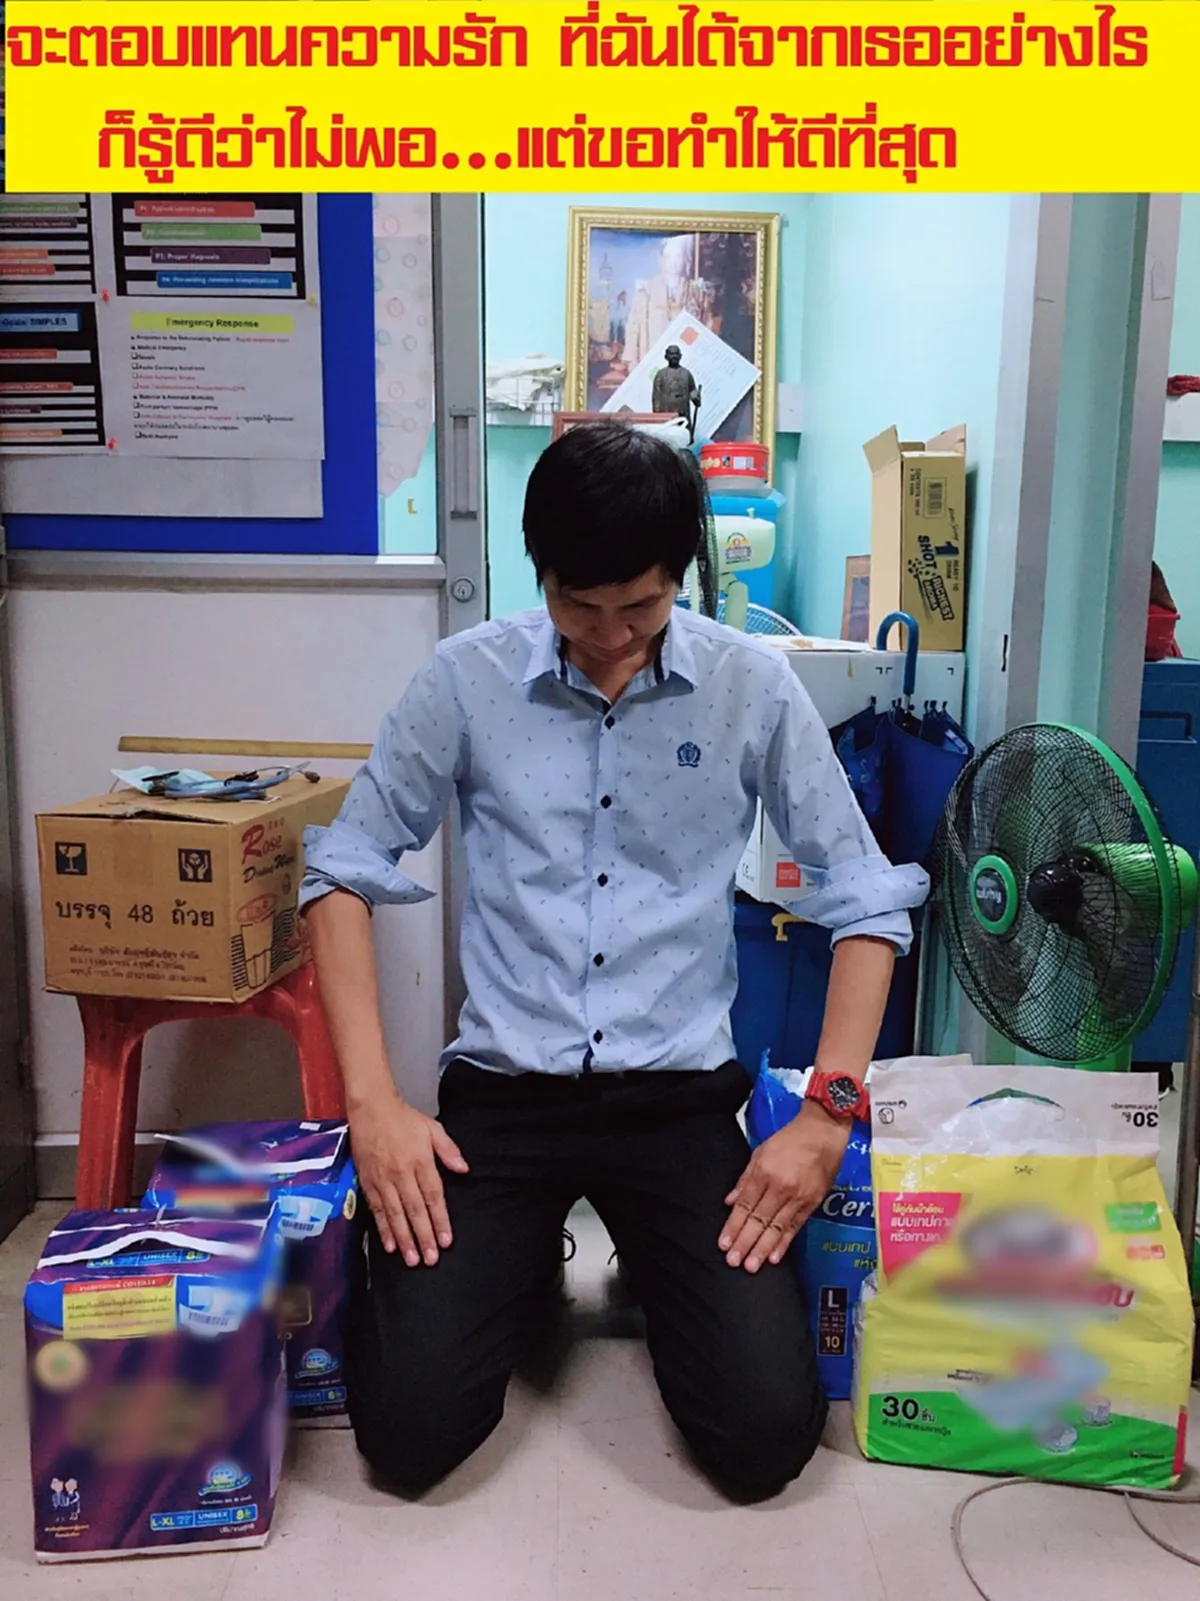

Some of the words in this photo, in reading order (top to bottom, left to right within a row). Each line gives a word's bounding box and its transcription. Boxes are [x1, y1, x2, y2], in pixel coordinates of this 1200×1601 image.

[190, 253, 220, 262] diagnosis
[166, 317, 214, 329] Emergency
[215, 318, 259, 328] Response
[917, 535, 937, 569] SHOT
[935, 541, 959, 556] 1
[924, 580, 938, 610] AROMA
[932, 577, 954, 620] RICHEST
[241, 825, 283, 865] Rose
[55, 901, 112, 930] บรรจุ
[128, 904, 154, 924] 48
[171, 898, 215, 927] ถ้วย
[1133, 1111, 1159, 1127] 30
[828, 1290, 840, 1308] L
[825, 1335, 840, 1349] 10
[882, 1396, 919, 1420] 30
[921, 1408, 936, 1423] ชิ้น
[151, 1516, 175, 1527] L-XL
